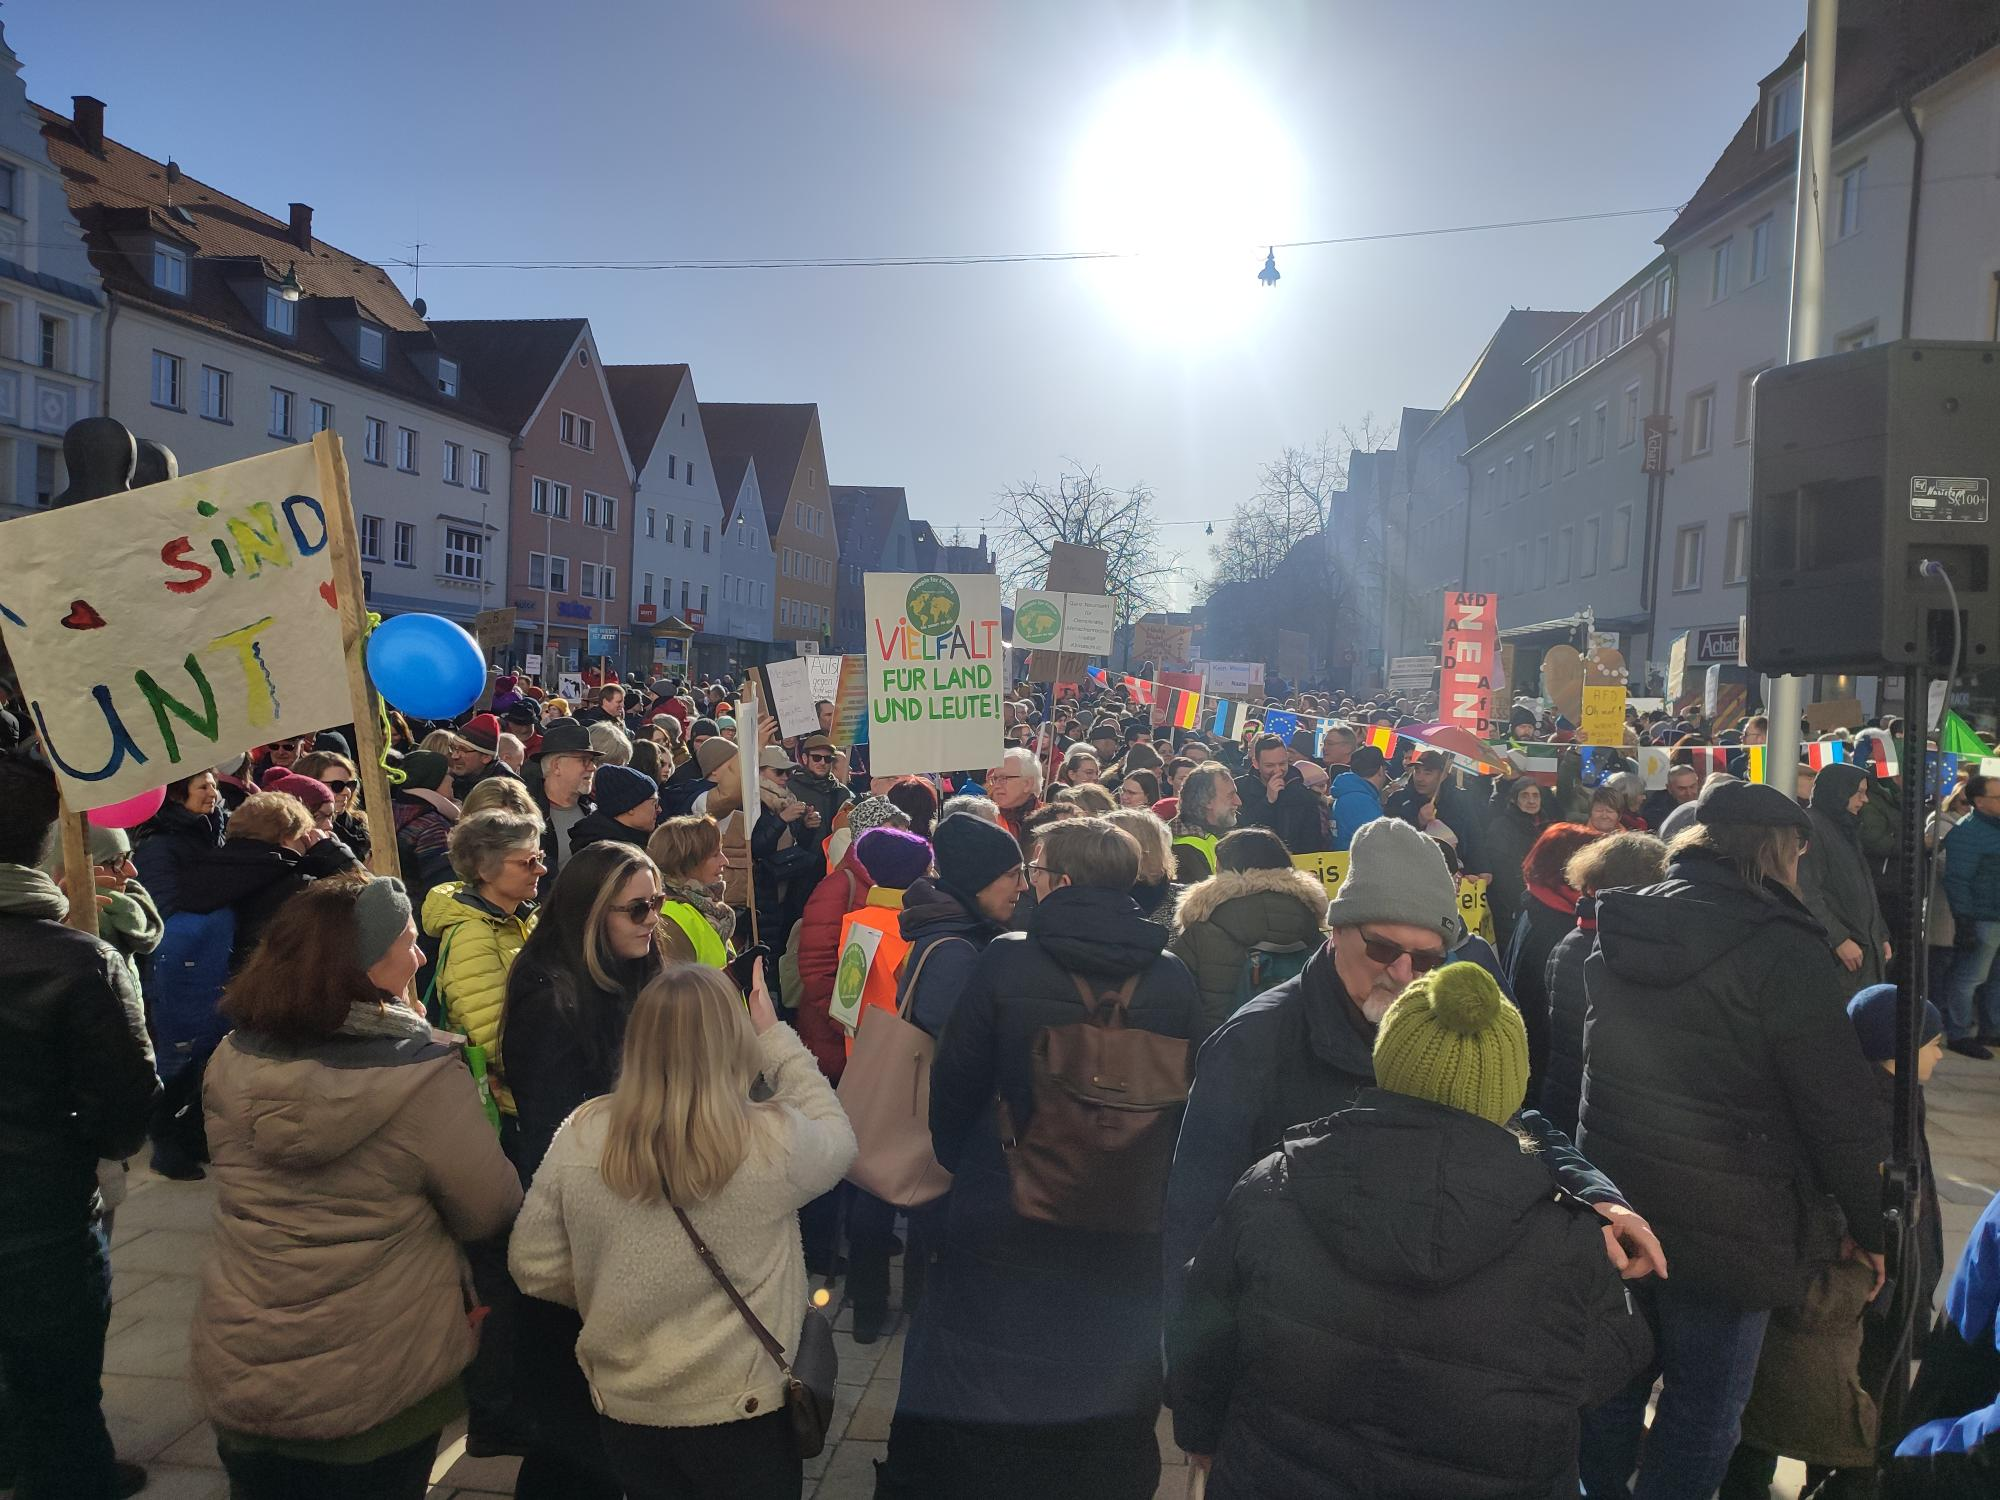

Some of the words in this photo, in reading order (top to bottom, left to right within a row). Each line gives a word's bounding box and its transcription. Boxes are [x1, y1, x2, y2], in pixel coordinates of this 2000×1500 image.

[1455, 593, 1488, 606] AfD
[1701, 634, 1739, 658] Achat
[883, 667, 927, 692] FÜR
[934, 663, 992, 690] LAND
[1453, 606, 1484, 736] NEIN
[873, 696, 923, 724] UND
[929, 693, 1001, 720] LEUTE!
